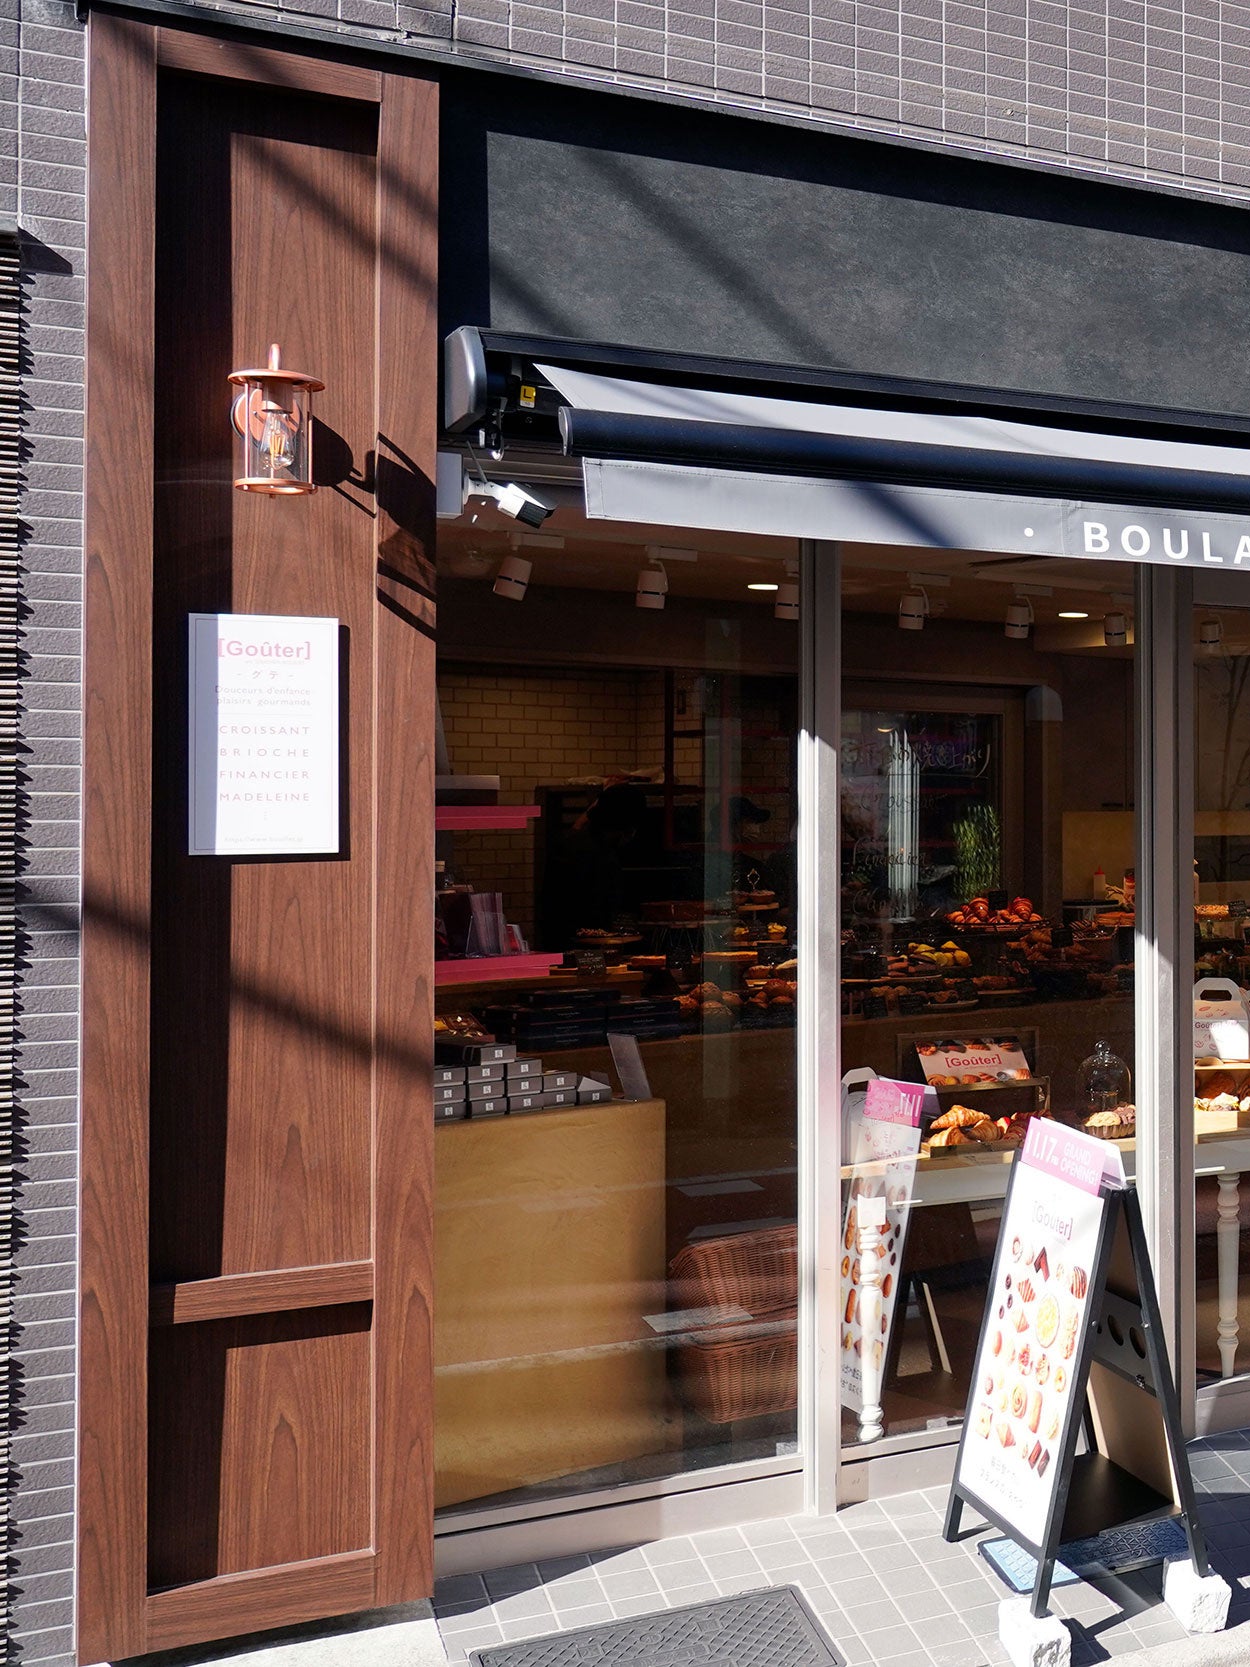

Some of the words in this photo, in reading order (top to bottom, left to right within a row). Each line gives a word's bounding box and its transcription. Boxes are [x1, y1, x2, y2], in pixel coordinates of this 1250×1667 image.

[219, 725, 310, 735] CROISSANT
[219, 748, 310, 758] BRIOCHE
[219, 770, 310, 780] FINANCIER
[219, 792, 310, 802] MADELEINE
[1063, 1141, 1092, 1167] GRAND
